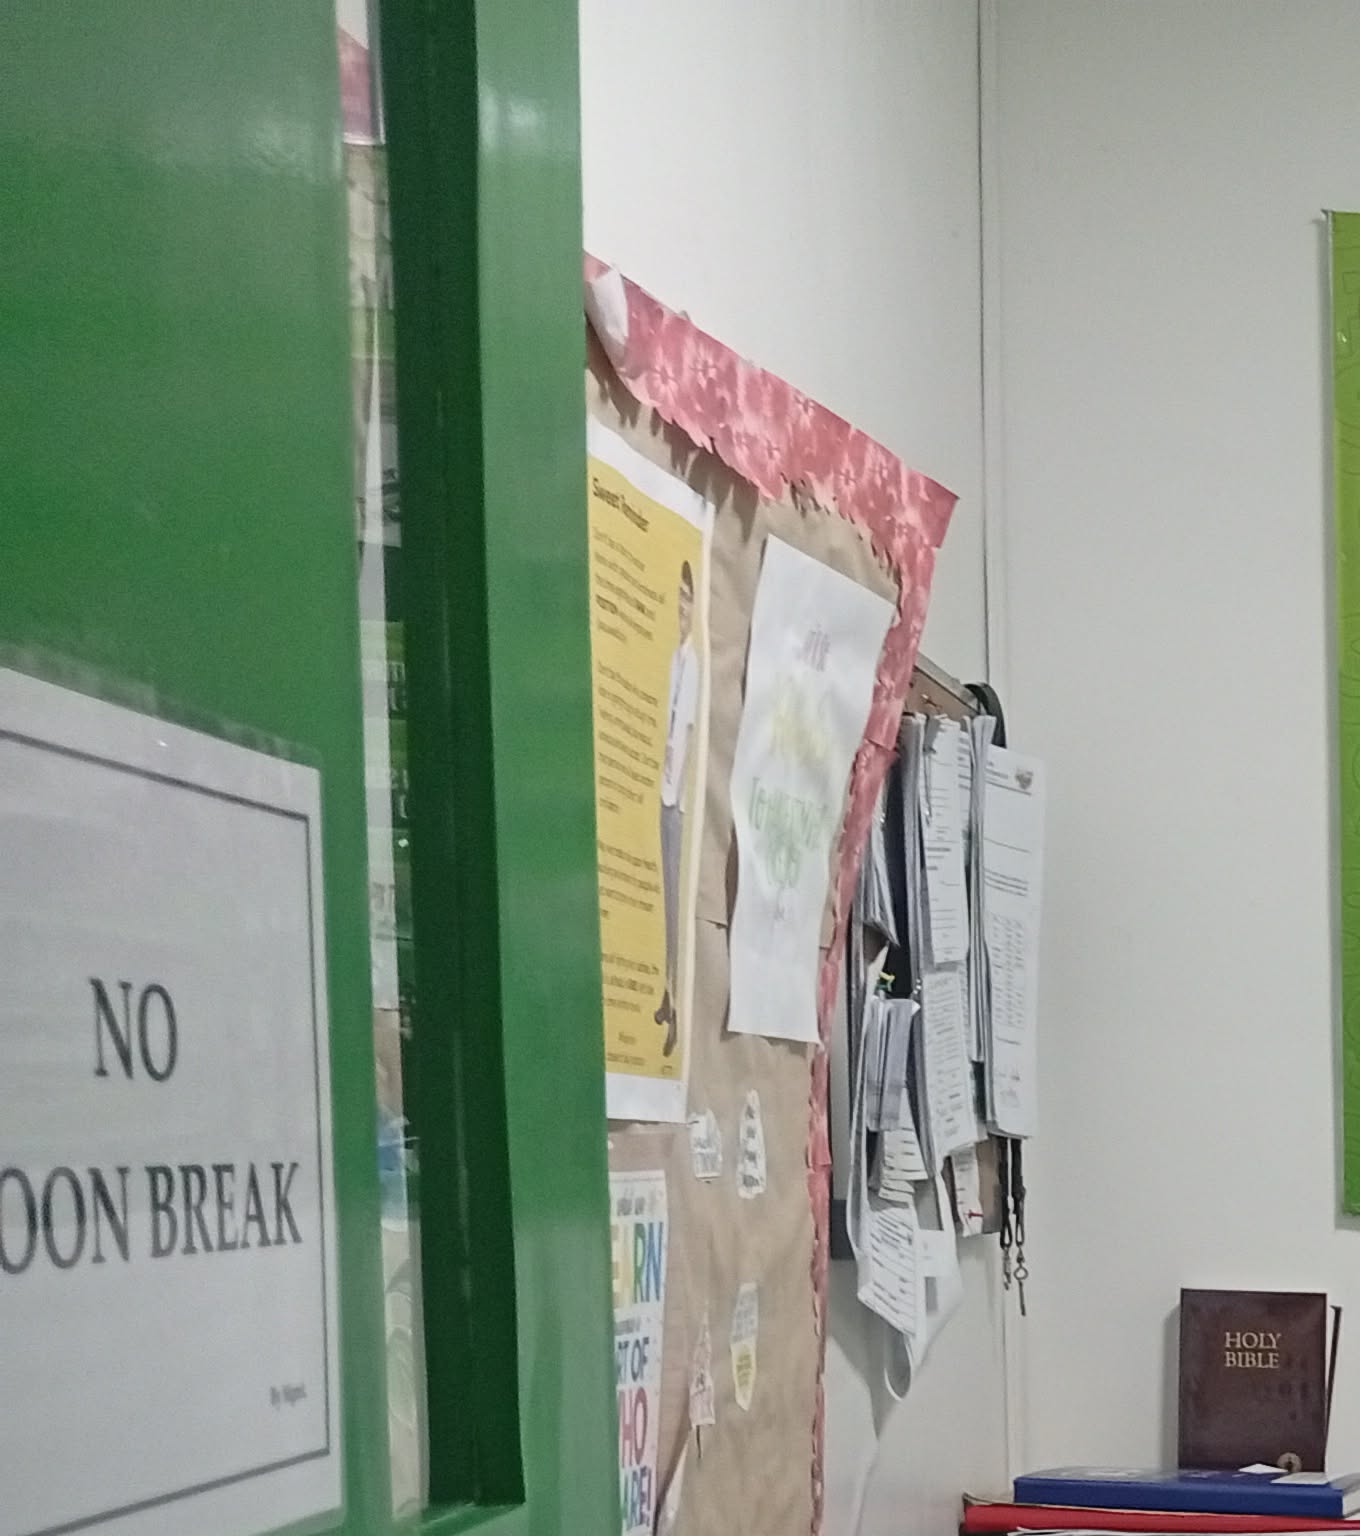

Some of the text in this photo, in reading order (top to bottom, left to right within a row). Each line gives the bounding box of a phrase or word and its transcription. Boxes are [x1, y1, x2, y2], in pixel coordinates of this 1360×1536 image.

[88, 976, 178, 1083] NO
[144, 1161, 303, 1259] BREAK
[1225, 1331, 1282, 1349] HOLY
[1225, 1351, 1280, 1369] BIBLE
